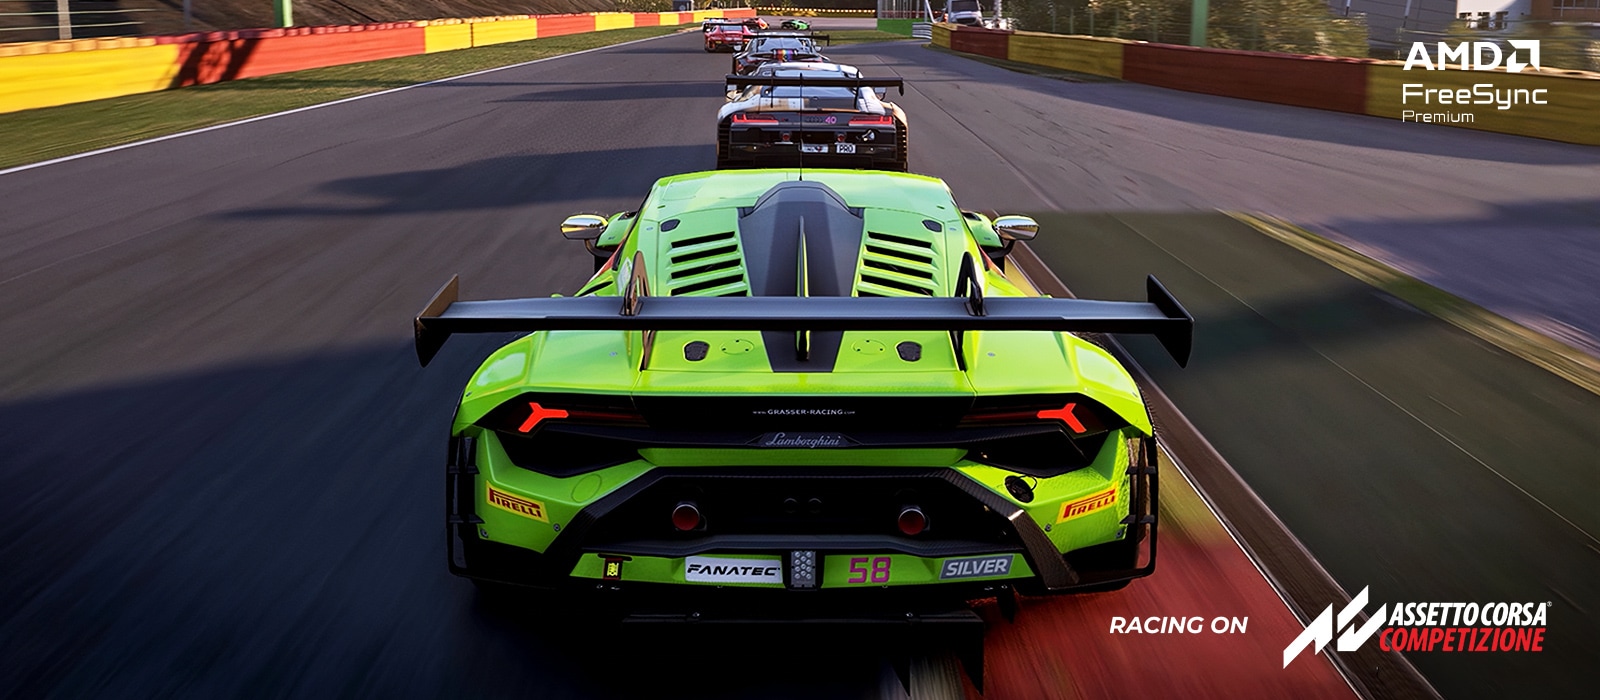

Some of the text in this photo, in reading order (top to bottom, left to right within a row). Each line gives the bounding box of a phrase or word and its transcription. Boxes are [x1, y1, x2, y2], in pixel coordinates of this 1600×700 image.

[824, 116, 837, 124] 40
[838, 144, 854, 153] PRO
[765, 431, 842, 449] Lamborghini
[488, 487, 543, 519] PIRELLI
[1062, 488, 1117, 519] PIRELLI
[687, 563, 778, 576] FANATEC
[847, 556, 892, 584] 58
[945, 558, 1008, 577] SILVER
